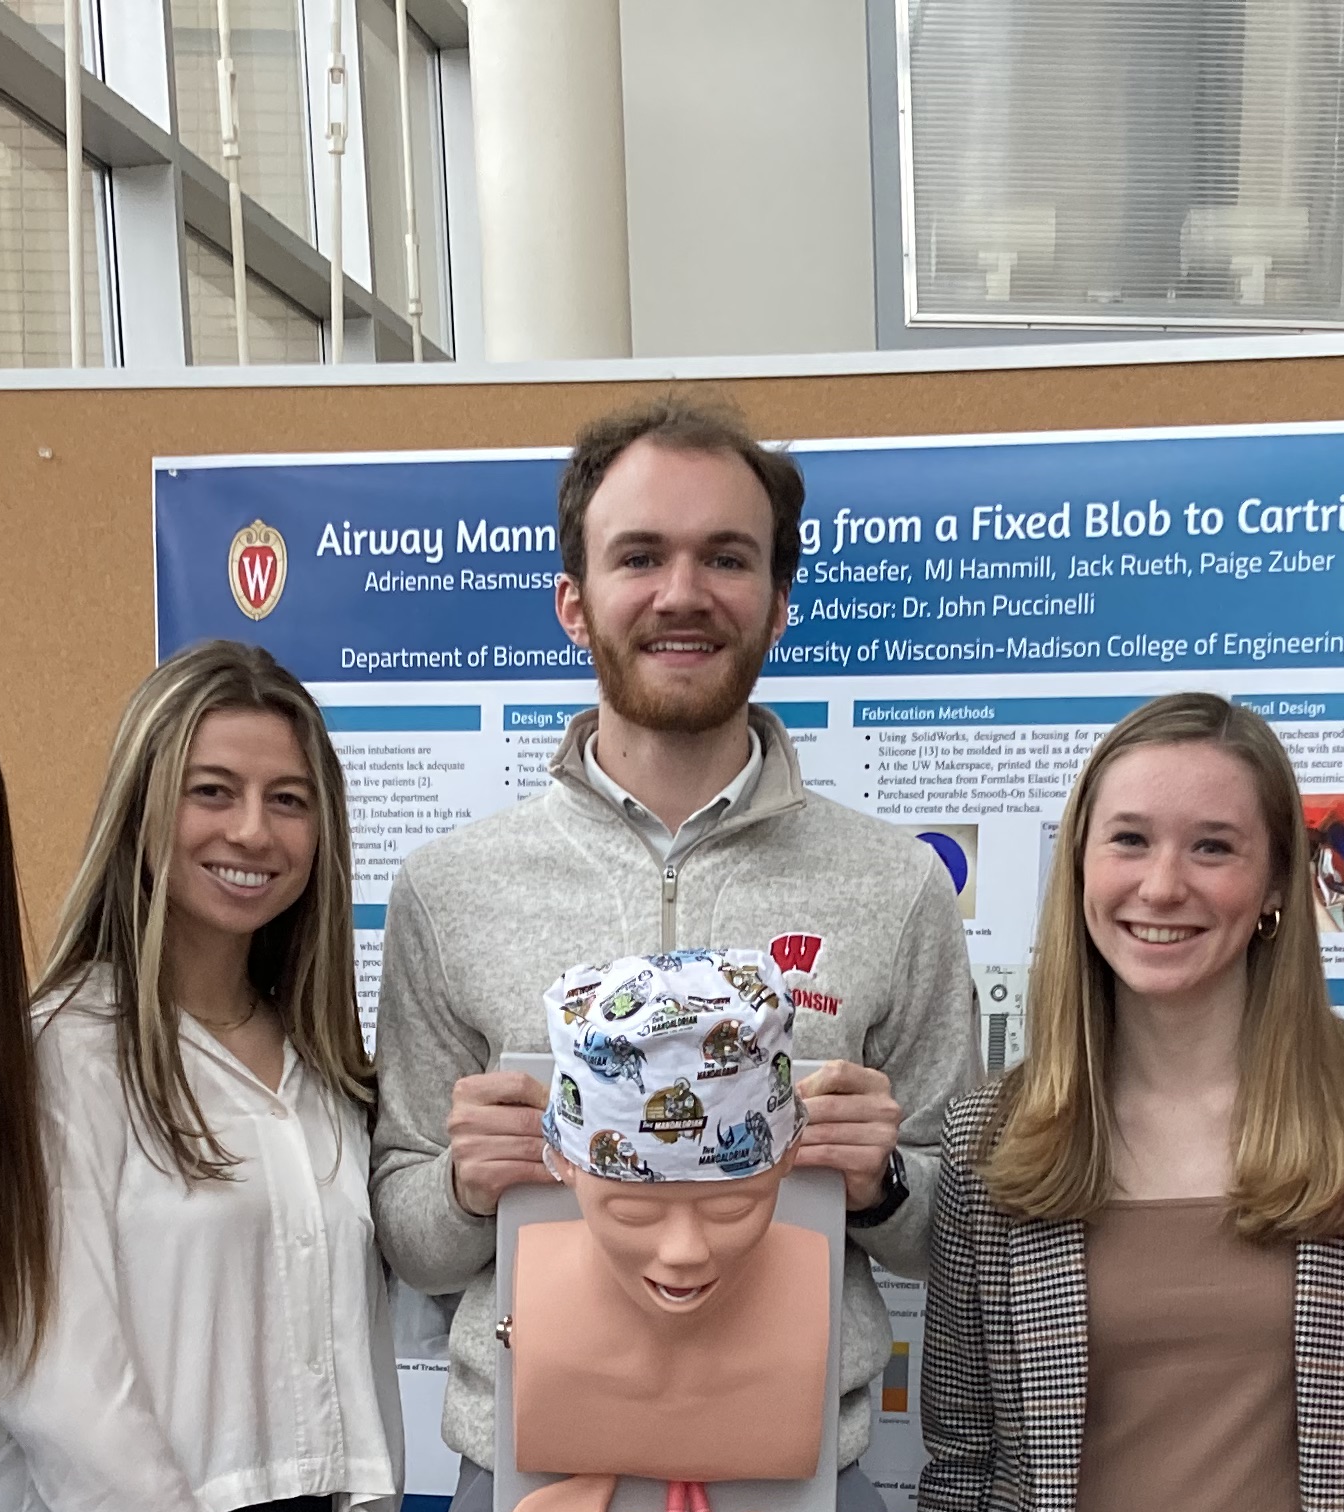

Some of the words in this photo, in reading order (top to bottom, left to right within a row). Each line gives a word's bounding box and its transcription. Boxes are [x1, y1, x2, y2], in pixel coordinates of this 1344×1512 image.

[316, 521, 444, 563] Airway
[457, 520, 556, 553] Mann
[832, 508, 922, 554] from
[935, 515, 957, 542] a
[972, 502, 1071, 540] Fixed
[1086, 499, 1171, 538] Blob
[1184, 503, 1223, 535] to
[364, 569, 455, 592] Adrienne
[460, 569, 563, 591] Rasmusse
[815, 558, 912, 585] Schaefer,
[925, 558, 953, 582] MJ
[960, 555, 1056, 581] Hammill,
[1068, 555, 1113, 579] Jack
[1121, 552, 1193, 577] Rueth,
[1200, 551, 1262, 579] Paige
[1268, 550, 1336, 573] Zuber
[811, 597, 897, 620] Advisor:
[903, 597, 931, 619] Dr.
[937, 595, 986, 618] John
[993, 592, 1095, 617] Puccinelli
[341, 648, 462, 674] Department
[467, 646, 488, 667] of
[494, 645, 596, 667] Biomedica
[857, 640, 881, 662] of
[885, 637, 1101, 661] Wisconsin-Madison
[1107, 634, 1188, 662] College
[1194, 633, 1219, 656] of
[862, 707, 935, 721] Fabrication
[939, 706, 995, 720] Methods
[1279, 700, 1326, 718] Design
[511, 711, 553, 728] Design
[879, 732, 907, 744] Using
[911, 731, 969, 742] SolidWorks,
[974, 731, 1016, 743] designed
[1031, 731, 1070, 742] housing
[1075, 730, 1089, 740] for
[1279, 729, 1319, 740] tracheas
[368, 746, 415, 755] intubations
[878, 747, 917, 756] Silicone
[941, 747, 950, 755] to
[953, 746, 964, 755] be
[967, 745, 1002, 755] molded
[1004, 745, 1014, 755] in
[1029, 745, 1050, 755] well
[1307, 743, 1329, 754] with
[517, 750, 545, 760] airway
[369, 761, 405, 771] students
[407, 761, 424, 771] lack
[427, 761, 466, 772] adequate
[517, 765, 535, 773] Two
[878, 761, 890, 771] At
[893, 761, 908, 771] the
[912, 760, 931, 771] UW
[935, 760, 993, 772] Makerspace,
[998, 760, 1031, 772] printed
[1035, 760, 1050, 769] the
[1053, 759, 1078, 769] mold
[382, 777, 416, 789] patients
[517, 779, 547, 787] Mimics
[877, 775, 917, 785] deviated
[919, 775, 953, 785] trachea
[955, 774, 978, 784] from
[981, 774, 1025, 784] Formlabs
[1028, 774, 1060, 784] Elastic
[391, 793, 439, 804] department
[877, 789, 925, 800] Purchased
[927, 789, 968, 801] pourable
[971, 789, 1025, 799] Smooth-On
[1028, 788, 1067, 798] Silicone
[434, 808, 454, 820] high
[455, 808, 473, 818] risk
[877, 804, 901, 814] mold
[903, 805, 913, 813] to
[914, 805, 943, 814] create
[945, 803, 960, 813] the
[962, 803, 1004, 815] designed
[405, 825, 424, 834] lead
[792, 988, 838, 1016] ONSIN
